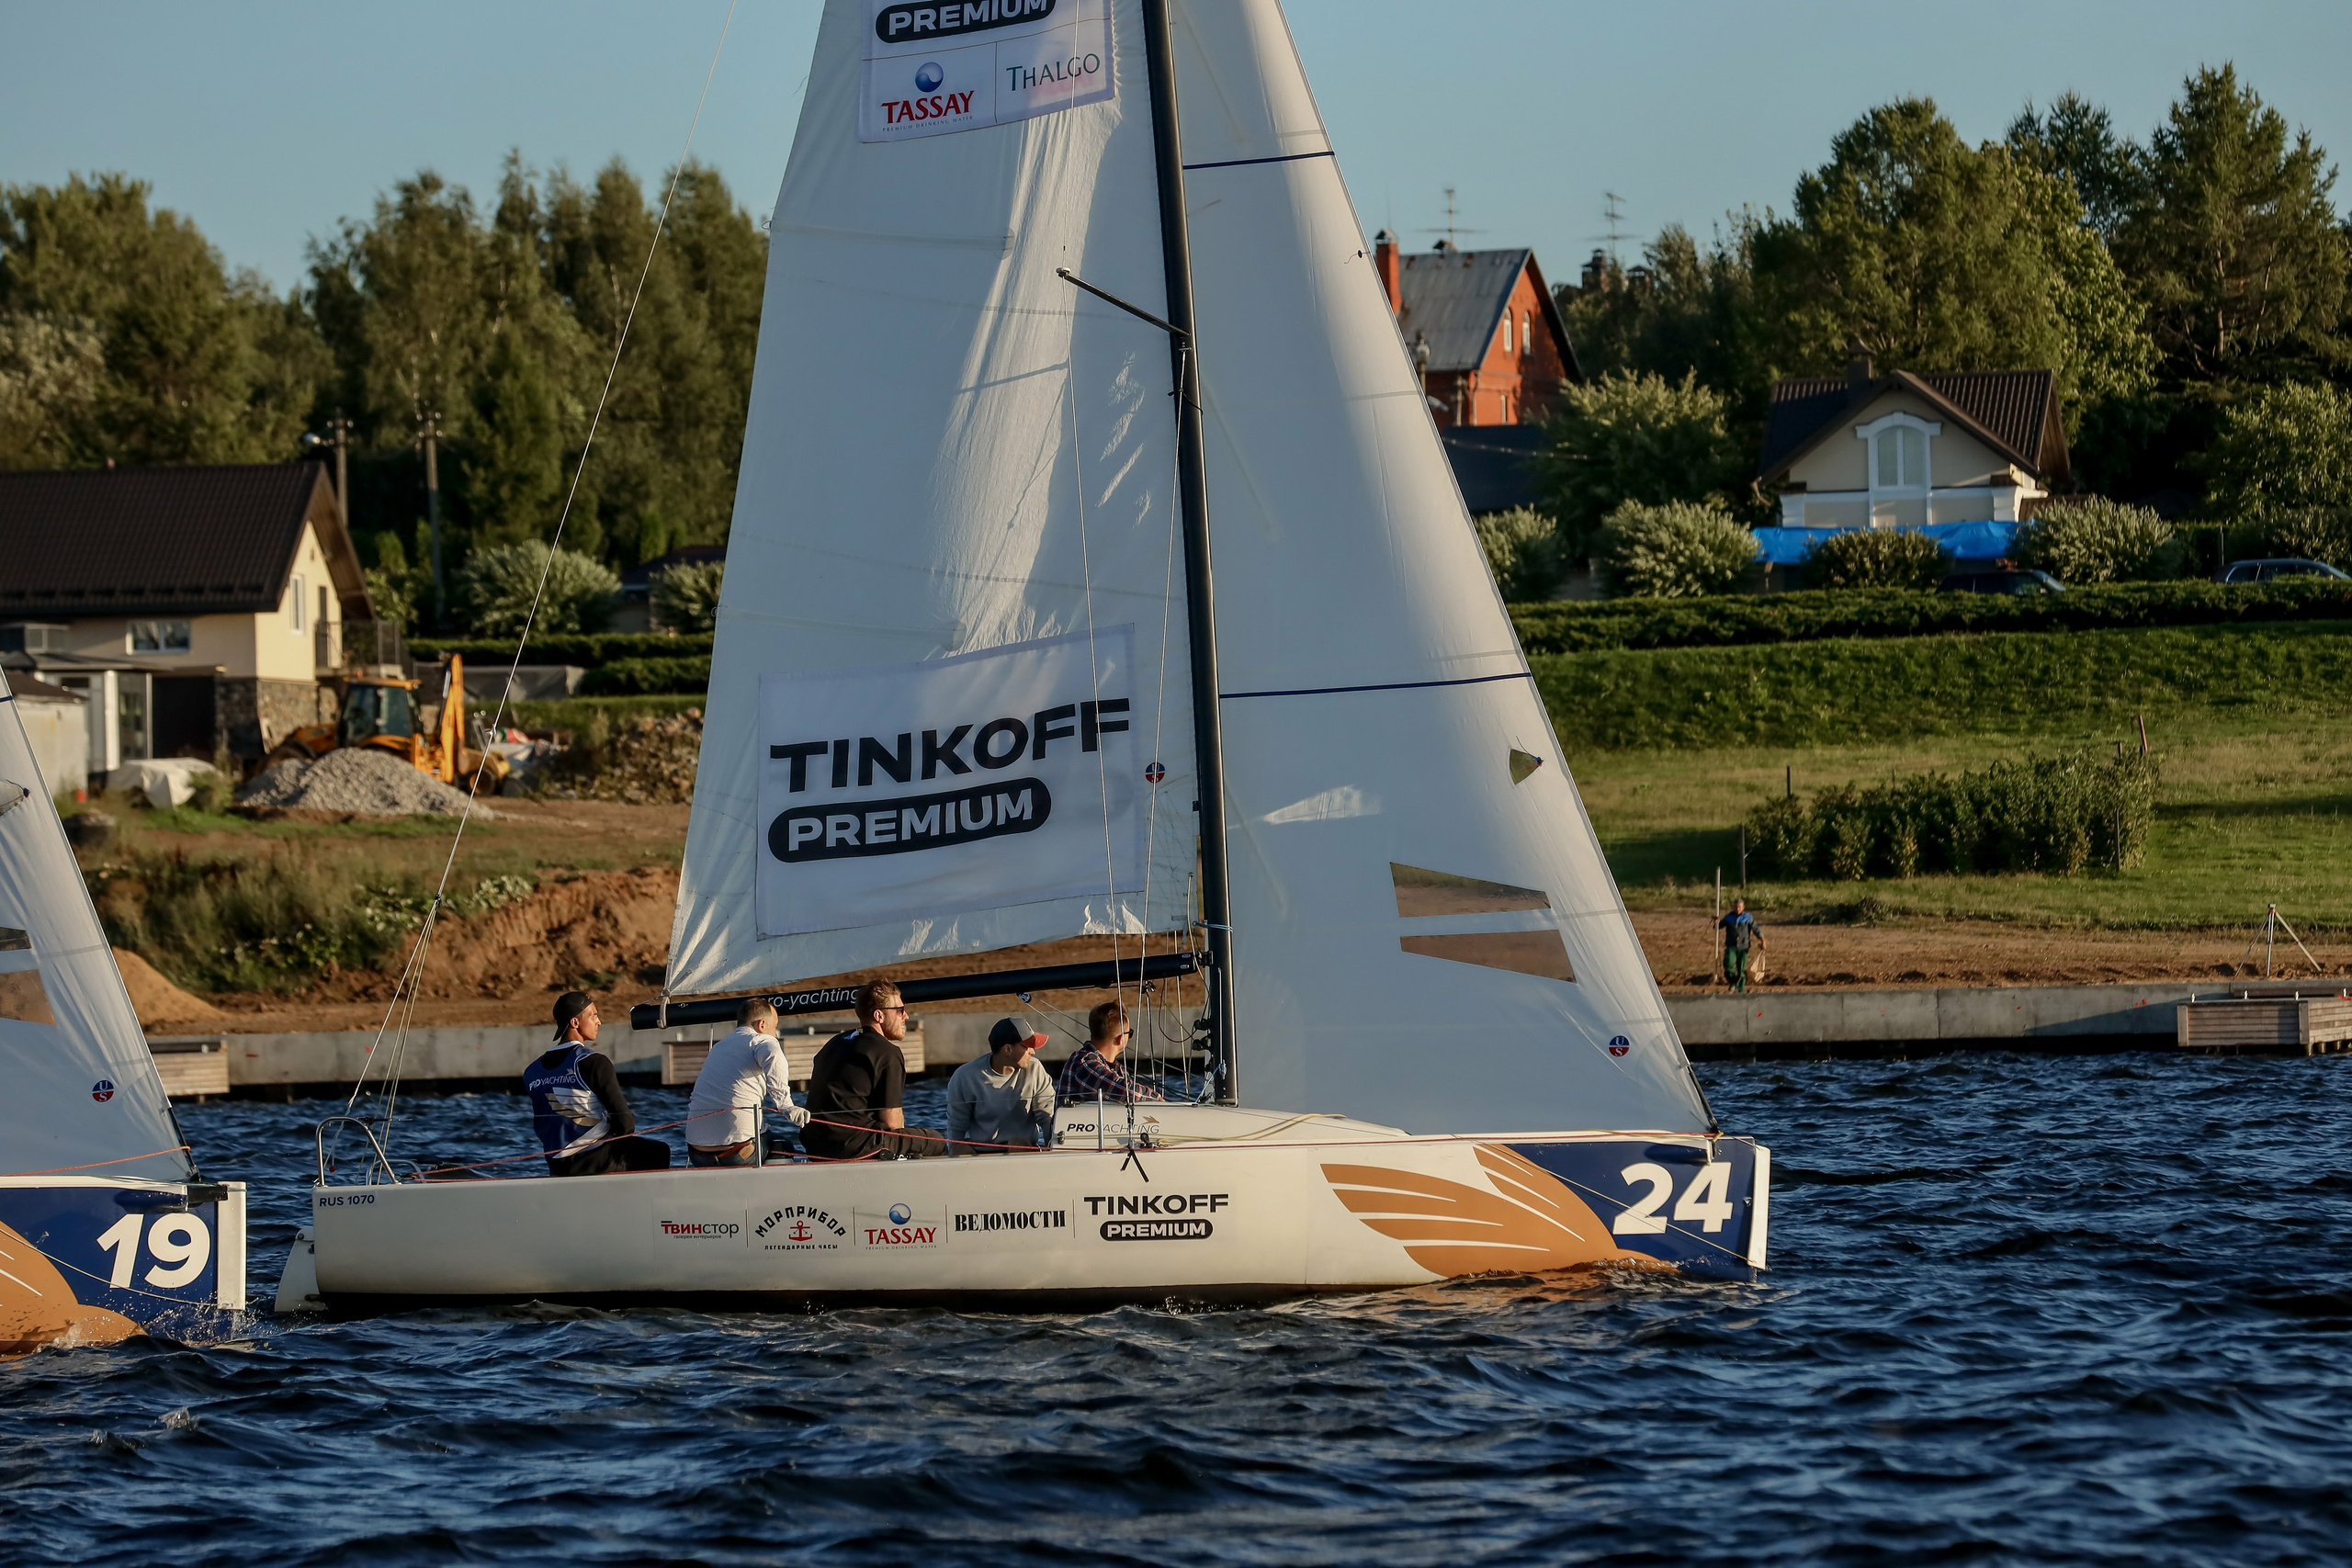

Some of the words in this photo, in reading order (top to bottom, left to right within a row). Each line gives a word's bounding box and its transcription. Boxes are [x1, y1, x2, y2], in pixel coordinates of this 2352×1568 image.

[888, 0, 1047, 35] PREMIUM
[1006, 53, 1101, 91] THALGO
[880, 90, 975, 124] TASSAY
[916, 119, 949, 128] DRINKING
[770, 698, 1130, 793] TINKOFF
[788, 788, 1034, 852] PREMIUM
[762, 988, 860, 1010] ro-yachting
[319, 1196, 345, 1207] RUS
[347, 1194, 375, 1205] 1070
[1084, 1194, 1229, 1215] TINKOFF
[1612, 1162, 1734, 1235] 24
[754, 1206, 847, 1238] МОРПРИБОР
[864, 1227, 937, 1245] TASSAY
[955, 1210, 1067, 1233] ВЕДОМОСТИ
[1107, 1223, 1205, 1237] PREMIUM
[96, 1213, 210, 1289] 19
